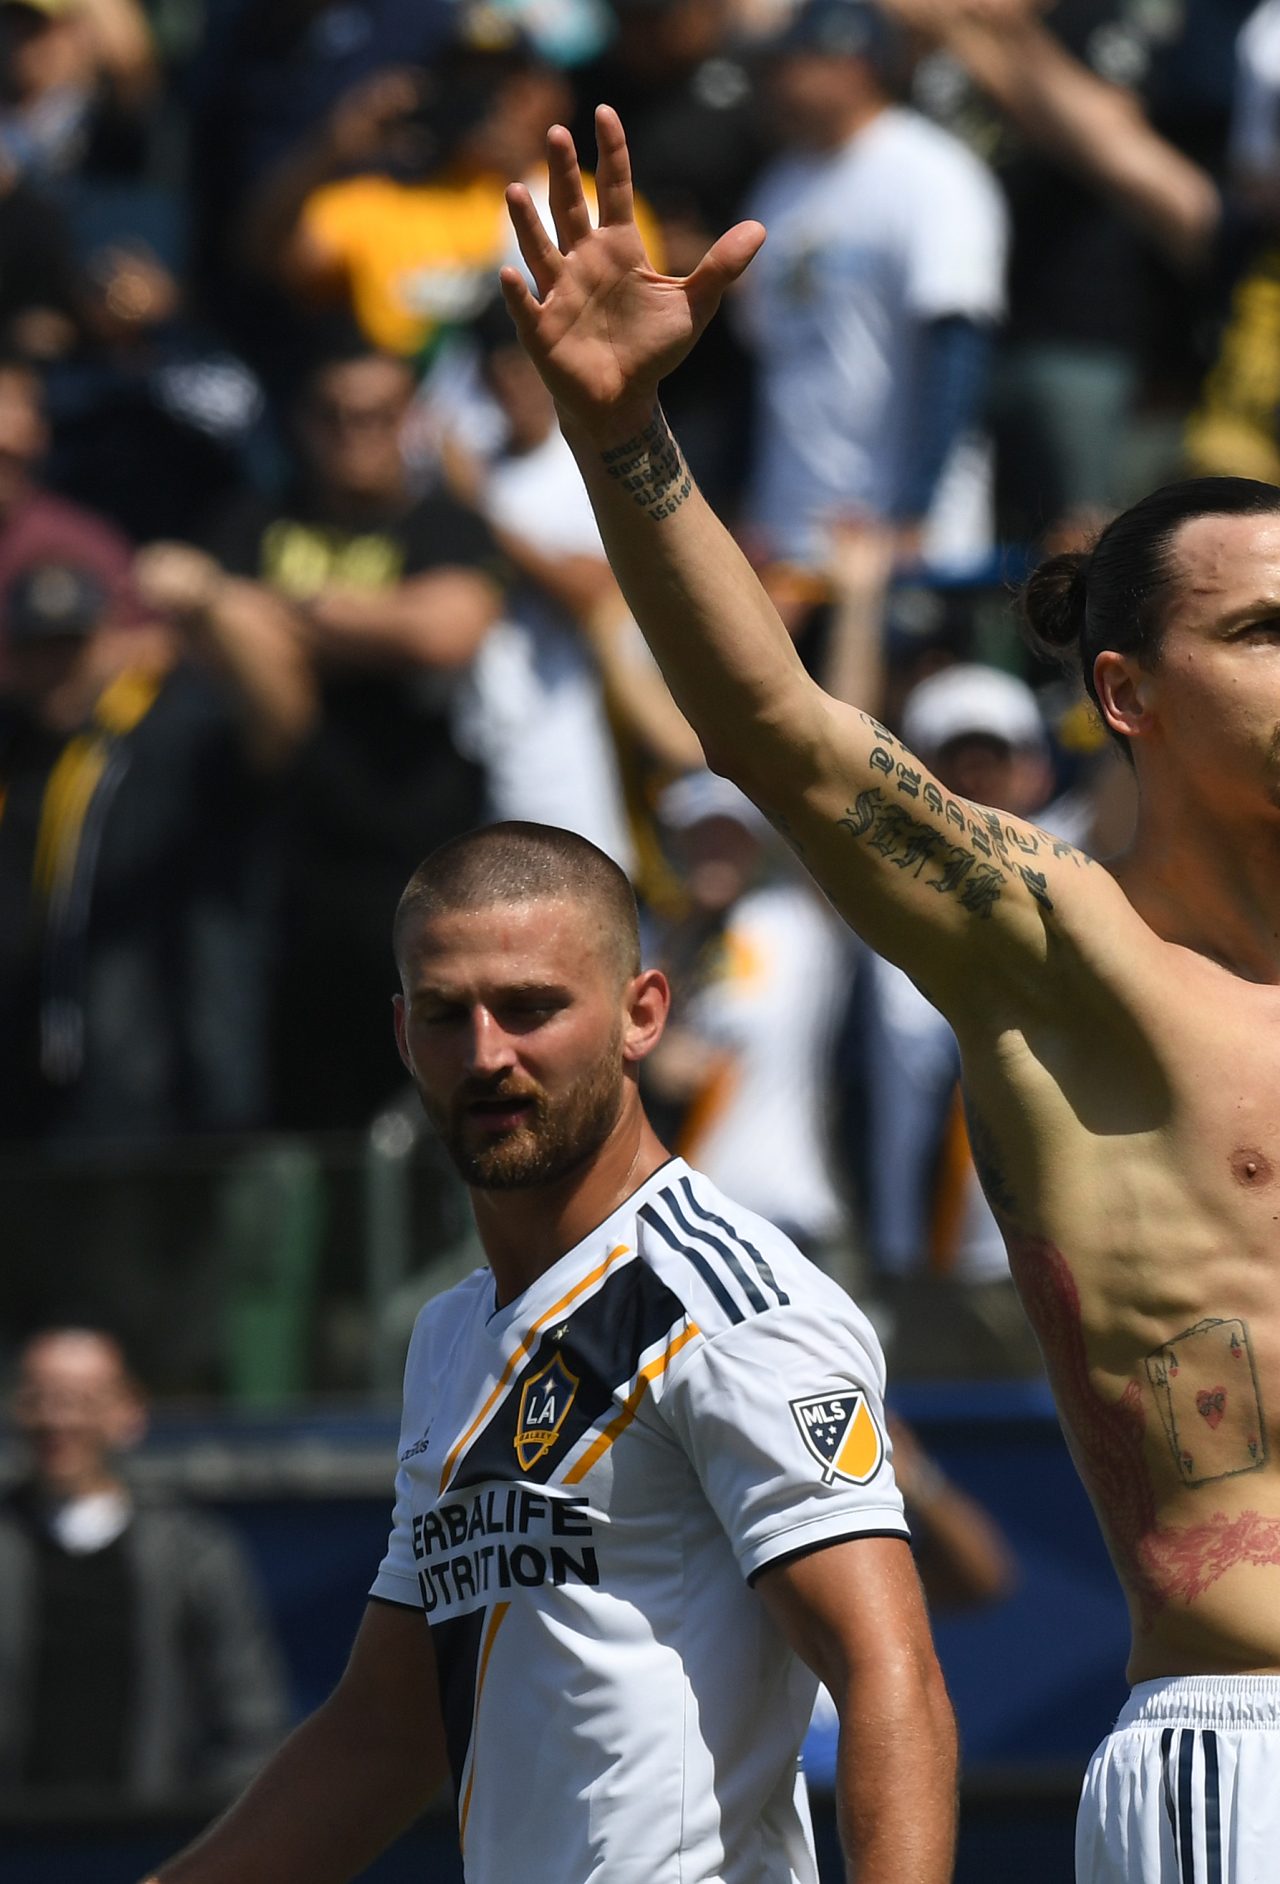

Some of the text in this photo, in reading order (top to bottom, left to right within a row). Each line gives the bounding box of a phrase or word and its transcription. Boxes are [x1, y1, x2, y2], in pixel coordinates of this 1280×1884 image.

[526, 1395, 555, 1425] LA
[802, 1401, 847, 1427] MLS
[412, 1490, 592, 1560] ERBALIFE
[418, 1544, 600, 1612] UTRITION
